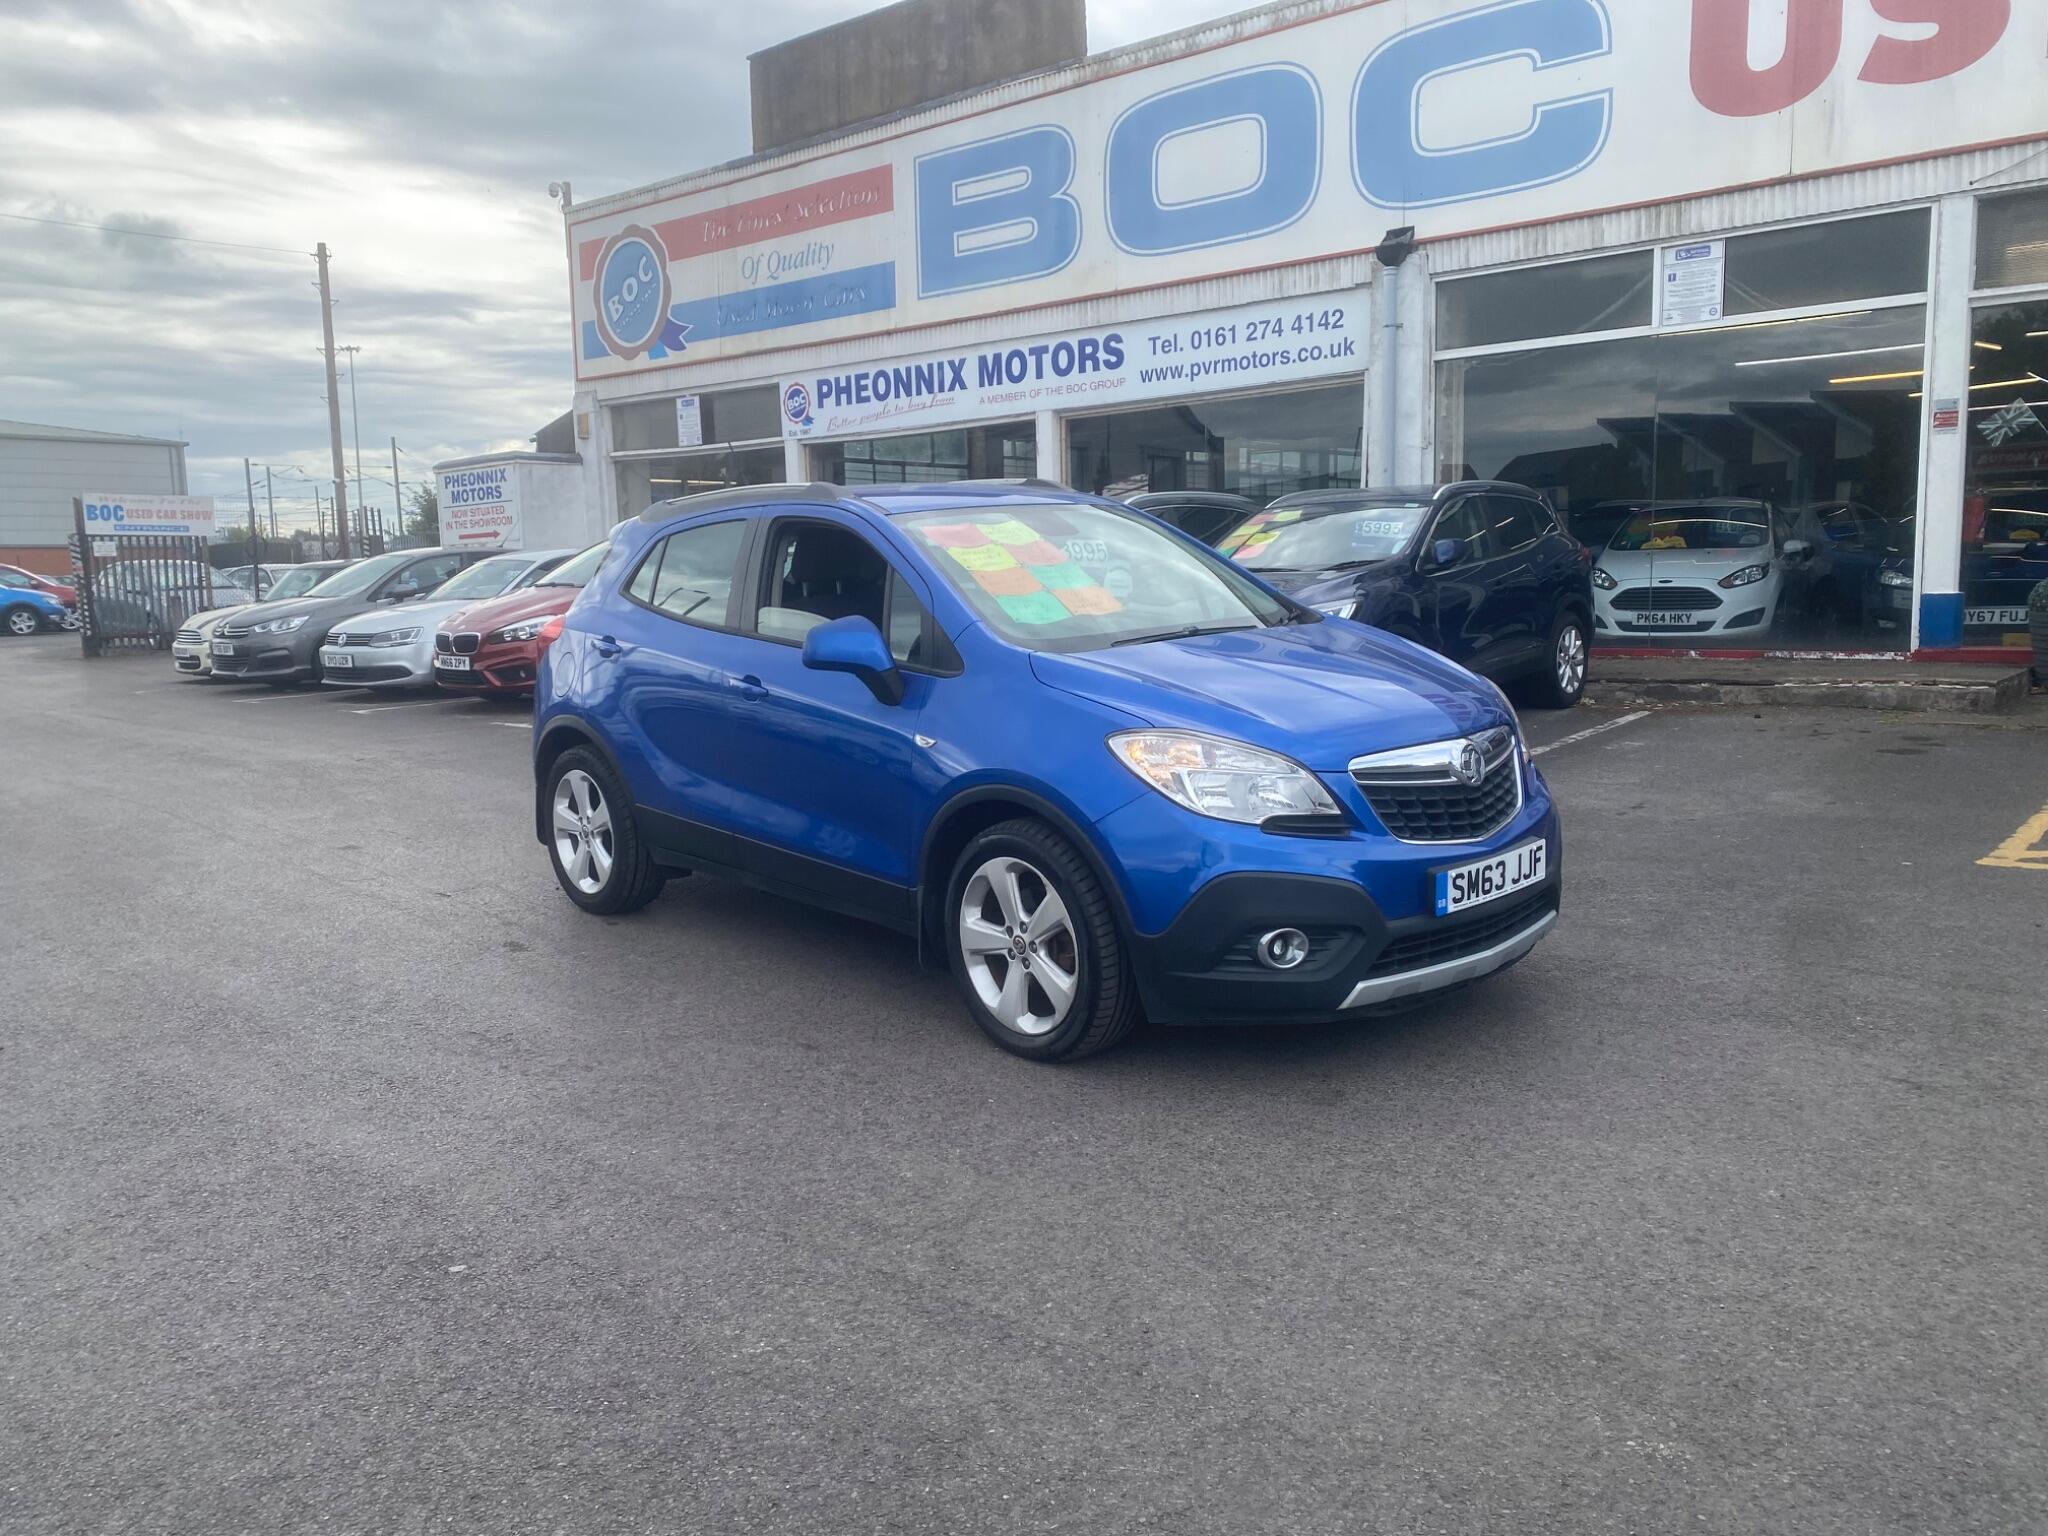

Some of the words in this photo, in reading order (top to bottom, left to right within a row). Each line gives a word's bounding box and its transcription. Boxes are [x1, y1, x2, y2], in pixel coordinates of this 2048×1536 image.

[914, 0, 1613, 299] BOC
[1690, 0, 2048, 116] US
[741, 252, 764, 285] Of
[766, 241, 835, 280] Quality
[608, 255, 654, 321] BOC
[1148, 333, 1184, 356] Tel.
[1190, 324, 1237, 350] 0161
[1245, 317, 1284, 342] 274
[1291, 308, 1345, 335] 4142
[817, 358, 968, 408] PHEONNIX
[978, 333, 1125, 388] MOTORS
[1139, 336, 1356, 384] www.pvrmotors.co.uk
[787, 392, 806, 410] BOC
[987, 391, 1026, 404] MEMBER
[1030, 388, 1043, 399] OF
[1045, 385, 1064, 397] THE
[1066, 382, 1088, 394] BOC
[1089, 377, 1126, 391] GROUP
[859, 402, 891, 425] people
[928, 393, 955, 409] from
[444, 468, 507, 489] PHEONNIX
[450, 485, 503, 504] MOTORS
[85, 504, 124, 521] BOC
[126, 508, 154, 520] USED
[156, 509, 178, 520] CAR
[180, 510, 213, 521] SHOW
[451, 509, 468, 520] NOW
[469, 505, 505, 517] SITUATED
[454, 520, 468, 530] THE
[469, 515, 513, 528] SHOWROOM
[1636, 613, 1666, 624] PK64
[1669, 612, 1692, 624] HKY
[1964, 610, 1996, 622] Y67
[1999, 609, 2029, 622] FUJ
[1451, 860, 1506, 904] SM63
[1511, 845, 1543, 885] JJF
